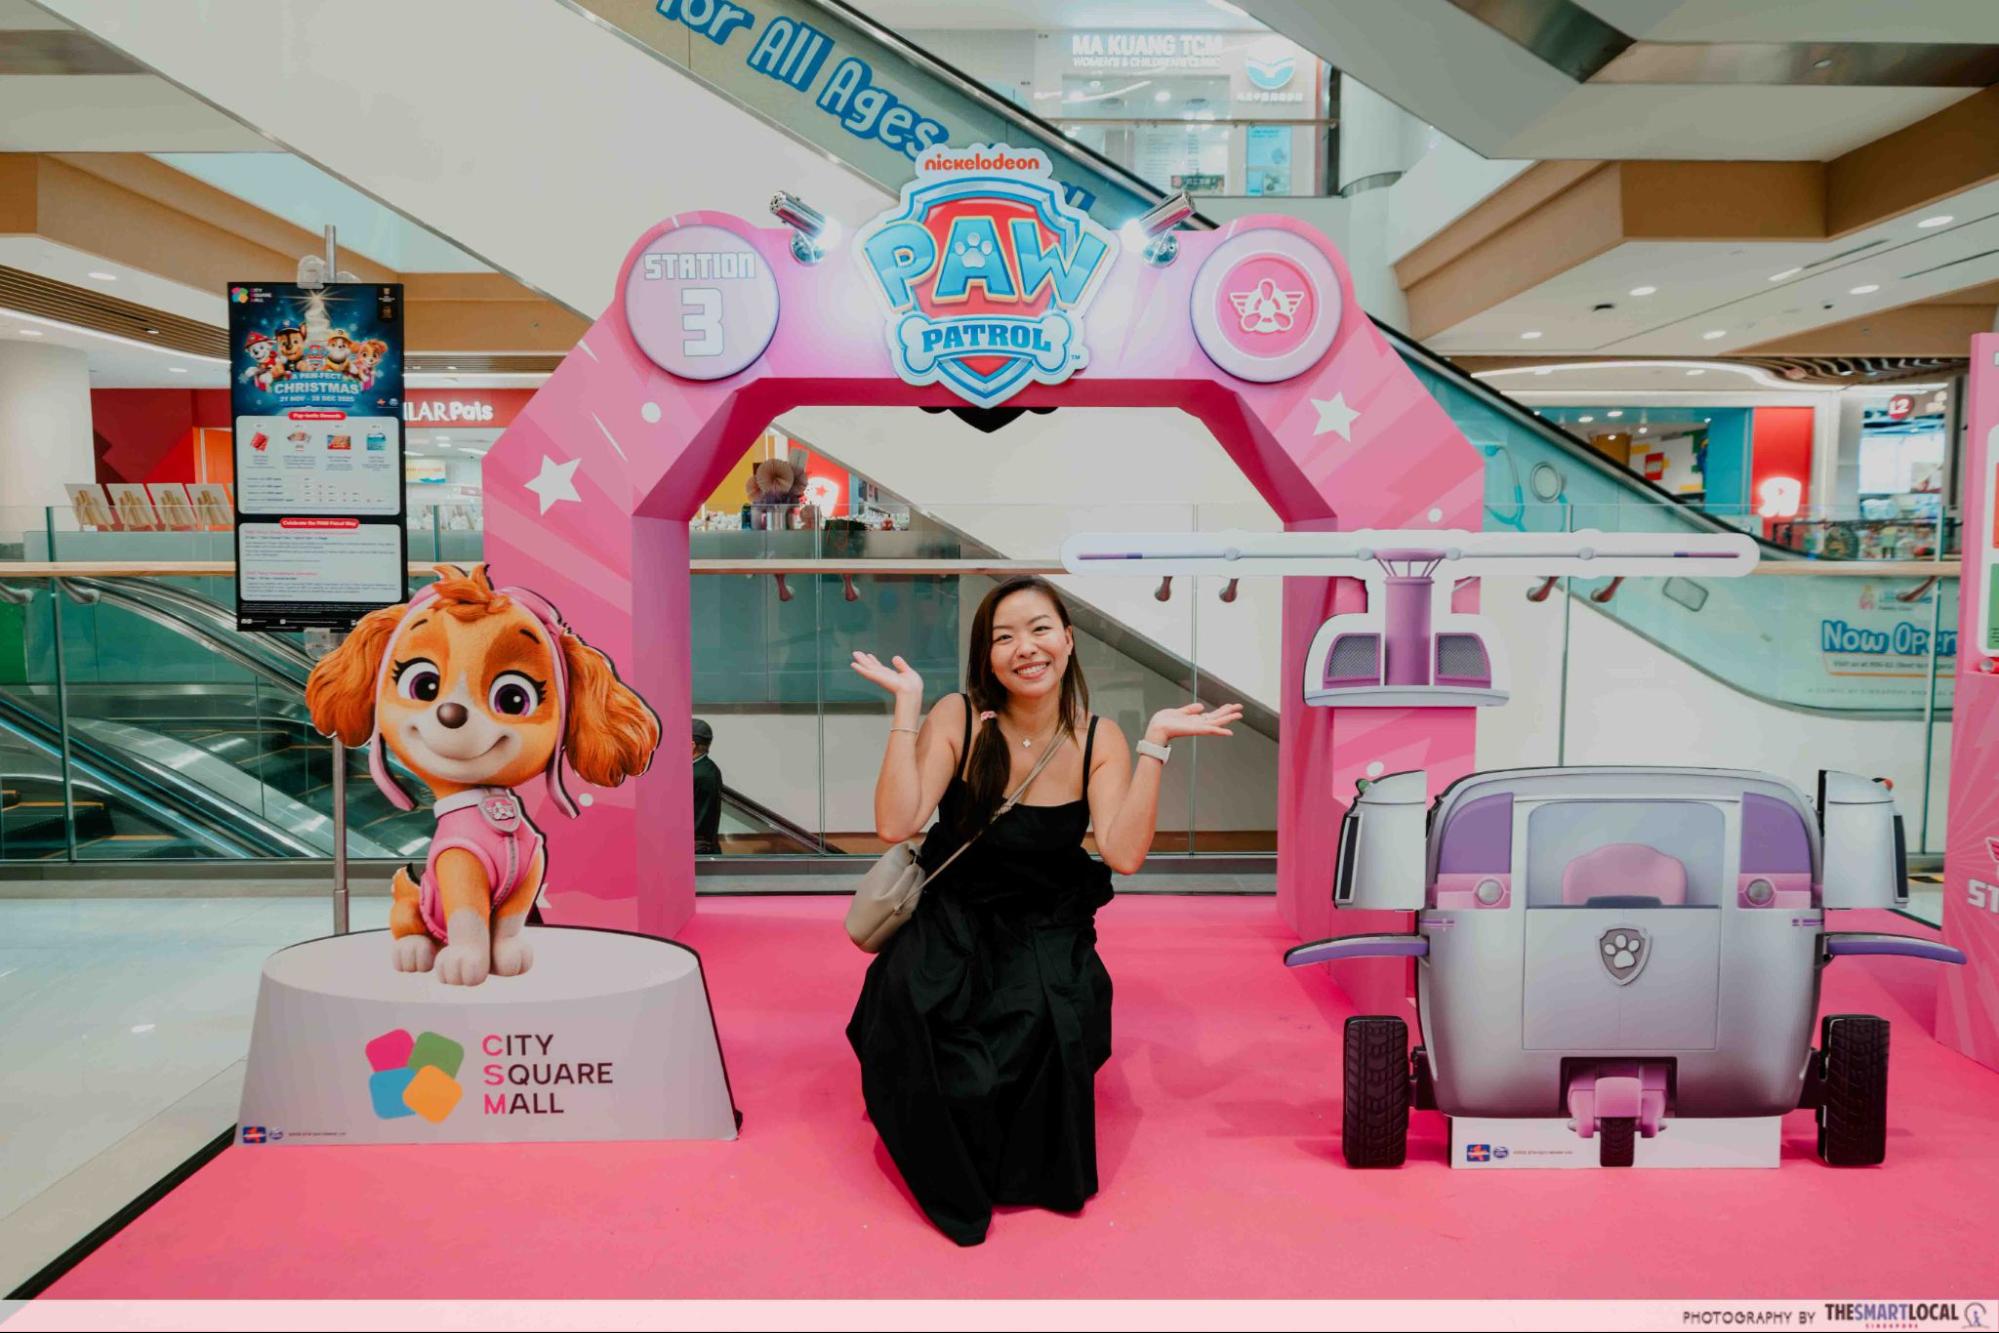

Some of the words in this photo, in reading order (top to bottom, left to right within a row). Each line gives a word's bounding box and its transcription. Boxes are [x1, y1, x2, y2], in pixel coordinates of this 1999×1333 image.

[1072, 34, 1104, 56] MA
[1108, 34, 1177, 56] KUANG
[1182, 34, 1223, 56] TCM
[747, 16, 836, 92] All
[816, 57, 949, 163] Ages
[924, 153, 1040, 171] nickelodeon
[643, 251, 757, 281] STATION
[863, 215, 1109, 314] PAW
[680, 286, 725, 358] 3
[921, 323, 1052, 353] PATROL
[274, 382, 359, 395] CHRISTMAS
[404, 401, 450, 421] LAR
[1822, 619, 1889, 654] Now
[482, 1033, 554, 1057] CITY
[483, 1062, 614, 1086] SQUARE
[483, 1093, 565, 1115] MALL
